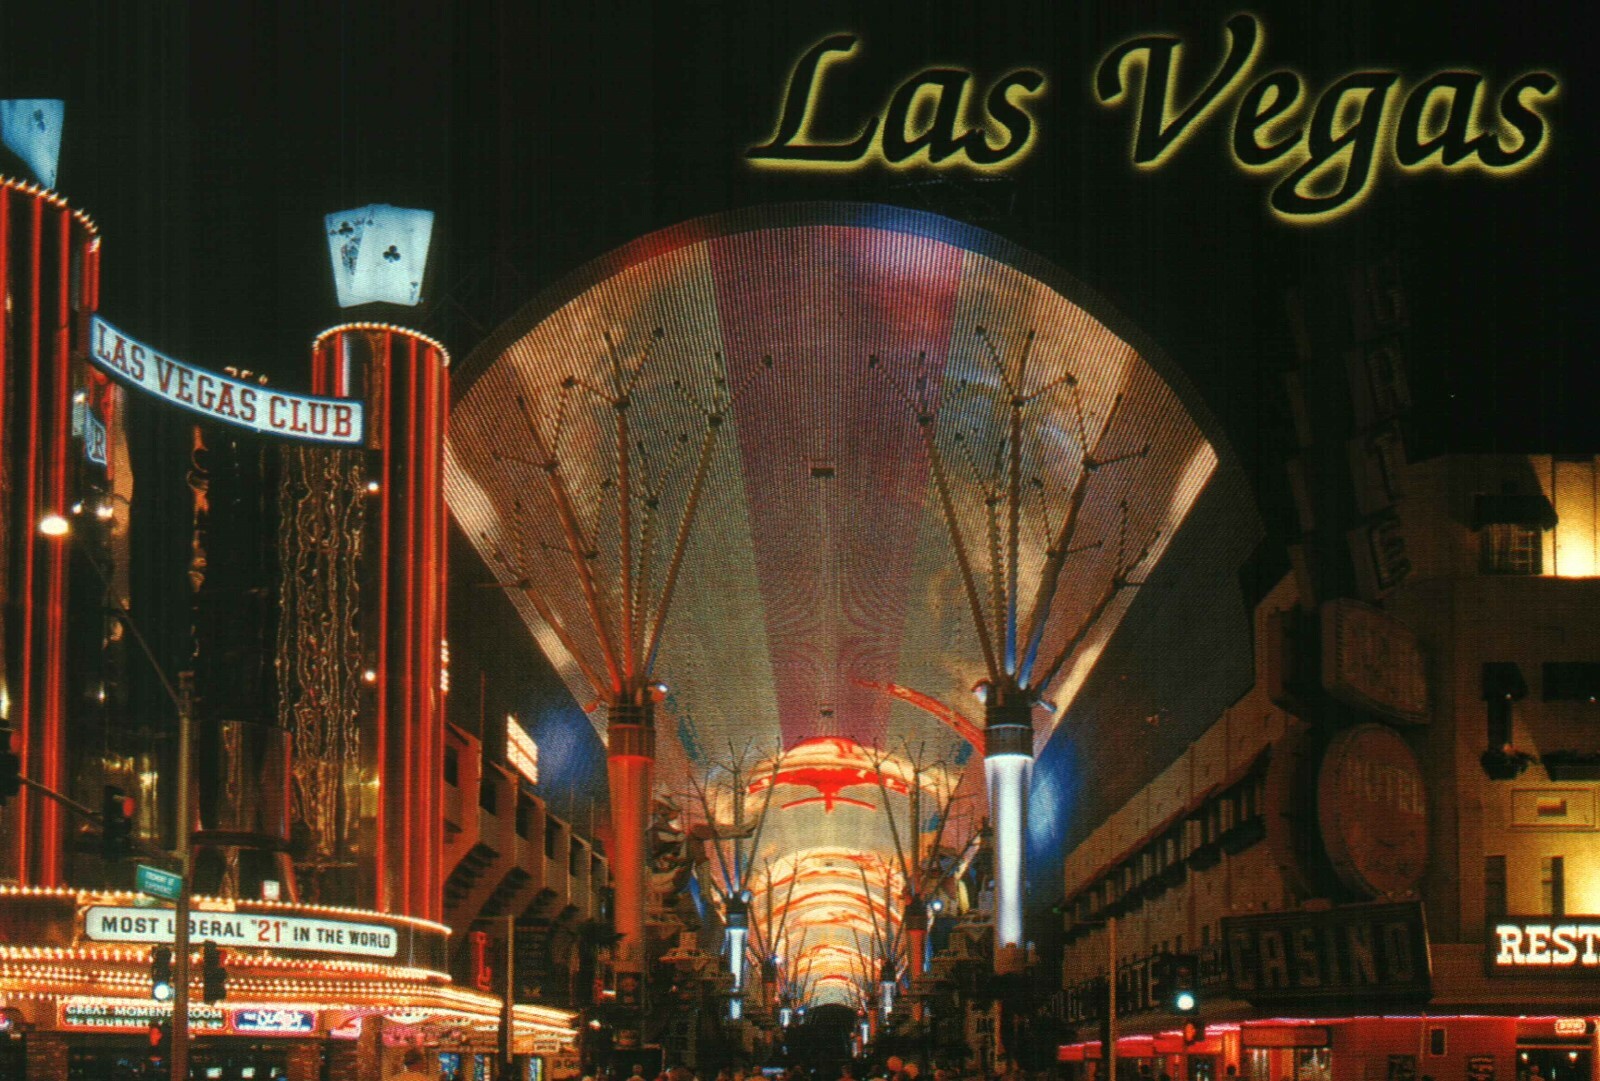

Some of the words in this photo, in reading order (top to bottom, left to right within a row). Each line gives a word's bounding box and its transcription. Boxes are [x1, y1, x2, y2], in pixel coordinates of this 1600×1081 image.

[97, 323, 146, 382] LAS
[153, 356, 257, 422] VEGAS
[269, 395, 354, 437] CLUB
[102, 916, 159, 933] MOST
[168, 918, 245, 938] LBERAL
[251, 919, 288, 942] "21"
[294, 926, 310, 942] IN
[317, 928, 344, 944] THE
[349, 930, 390, 949] WORLD
[1228, 922, 1413, 991] CASINO
[66, 1005, 107, 1015] GREAT
